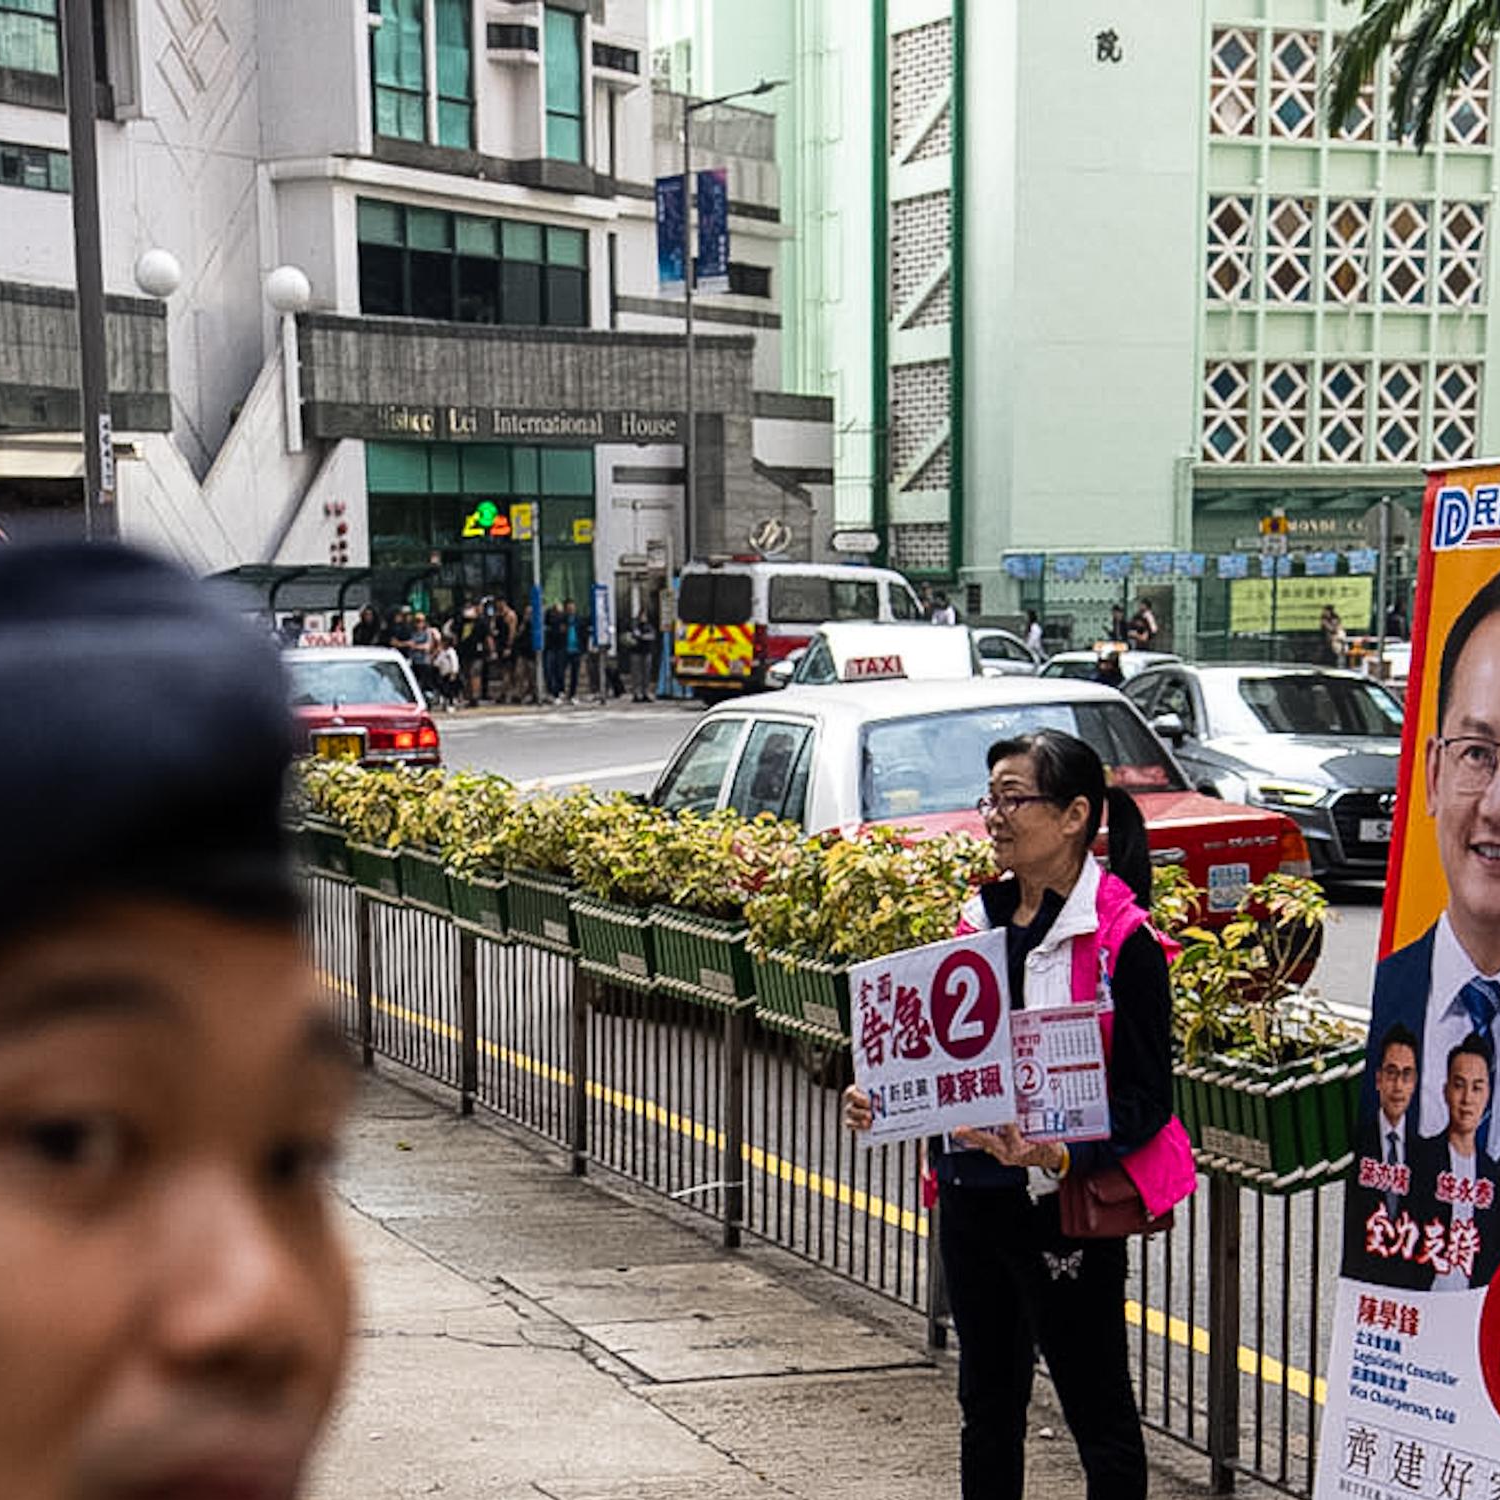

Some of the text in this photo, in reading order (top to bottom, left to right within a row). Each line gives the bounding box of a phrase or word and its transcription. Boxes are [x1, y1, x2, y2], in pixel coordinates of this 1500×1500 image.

[494, 410, 604, 435] International
[621, 412, 677, 436] House
[854, 655, 902, 676] TAXI
[857, 972, 893, 1010] 全面
[945, 965, 985, 1043] 2
[861, 985, 933, 1069] 告急
[937, 1063, 1005, 1108] 陳家珮
[1365, 1202, 1481, 1279] 全力支持
[1356, 1295, 1421, 1338] 陳學鋒
